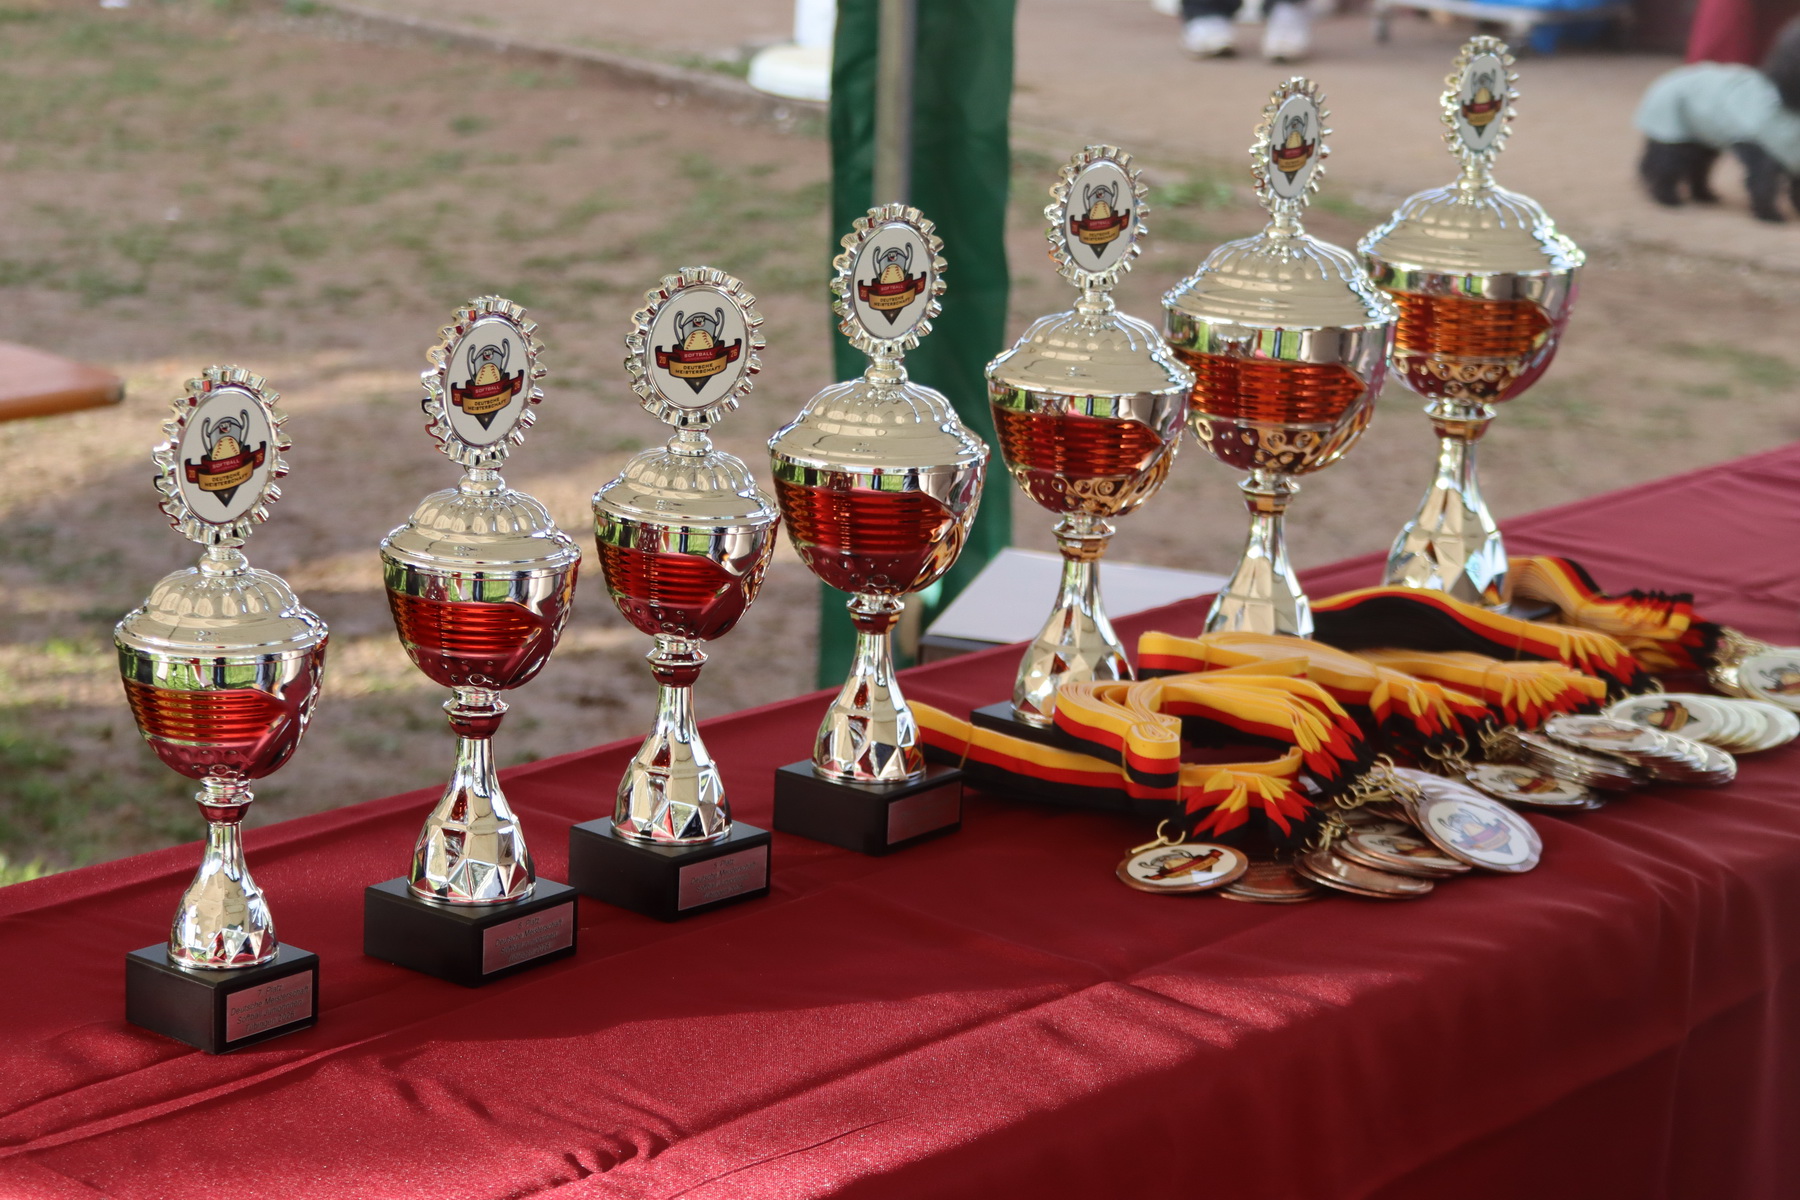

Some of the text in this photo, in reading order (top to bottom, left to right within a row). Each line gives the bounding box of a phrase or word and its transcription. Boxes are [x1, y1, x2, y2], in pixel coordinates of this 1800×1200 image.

[675, 365, 721, 375] MEISTERSCHAFT
[475, 385, 500, 394] SOFTBALL
[467, 399, 506, 411] MEISTERSCHAFT
[474, 397, 500, 406] DEUTSCHE
[212, 459, 240, 469] SOFTBALL
[204, 472, 249, 487] MEISTERSCHAFT
[211, 472, 240, 482] DEUTSCHE
[231, 985, 309, 1016] Deutsche Meisterschaft
